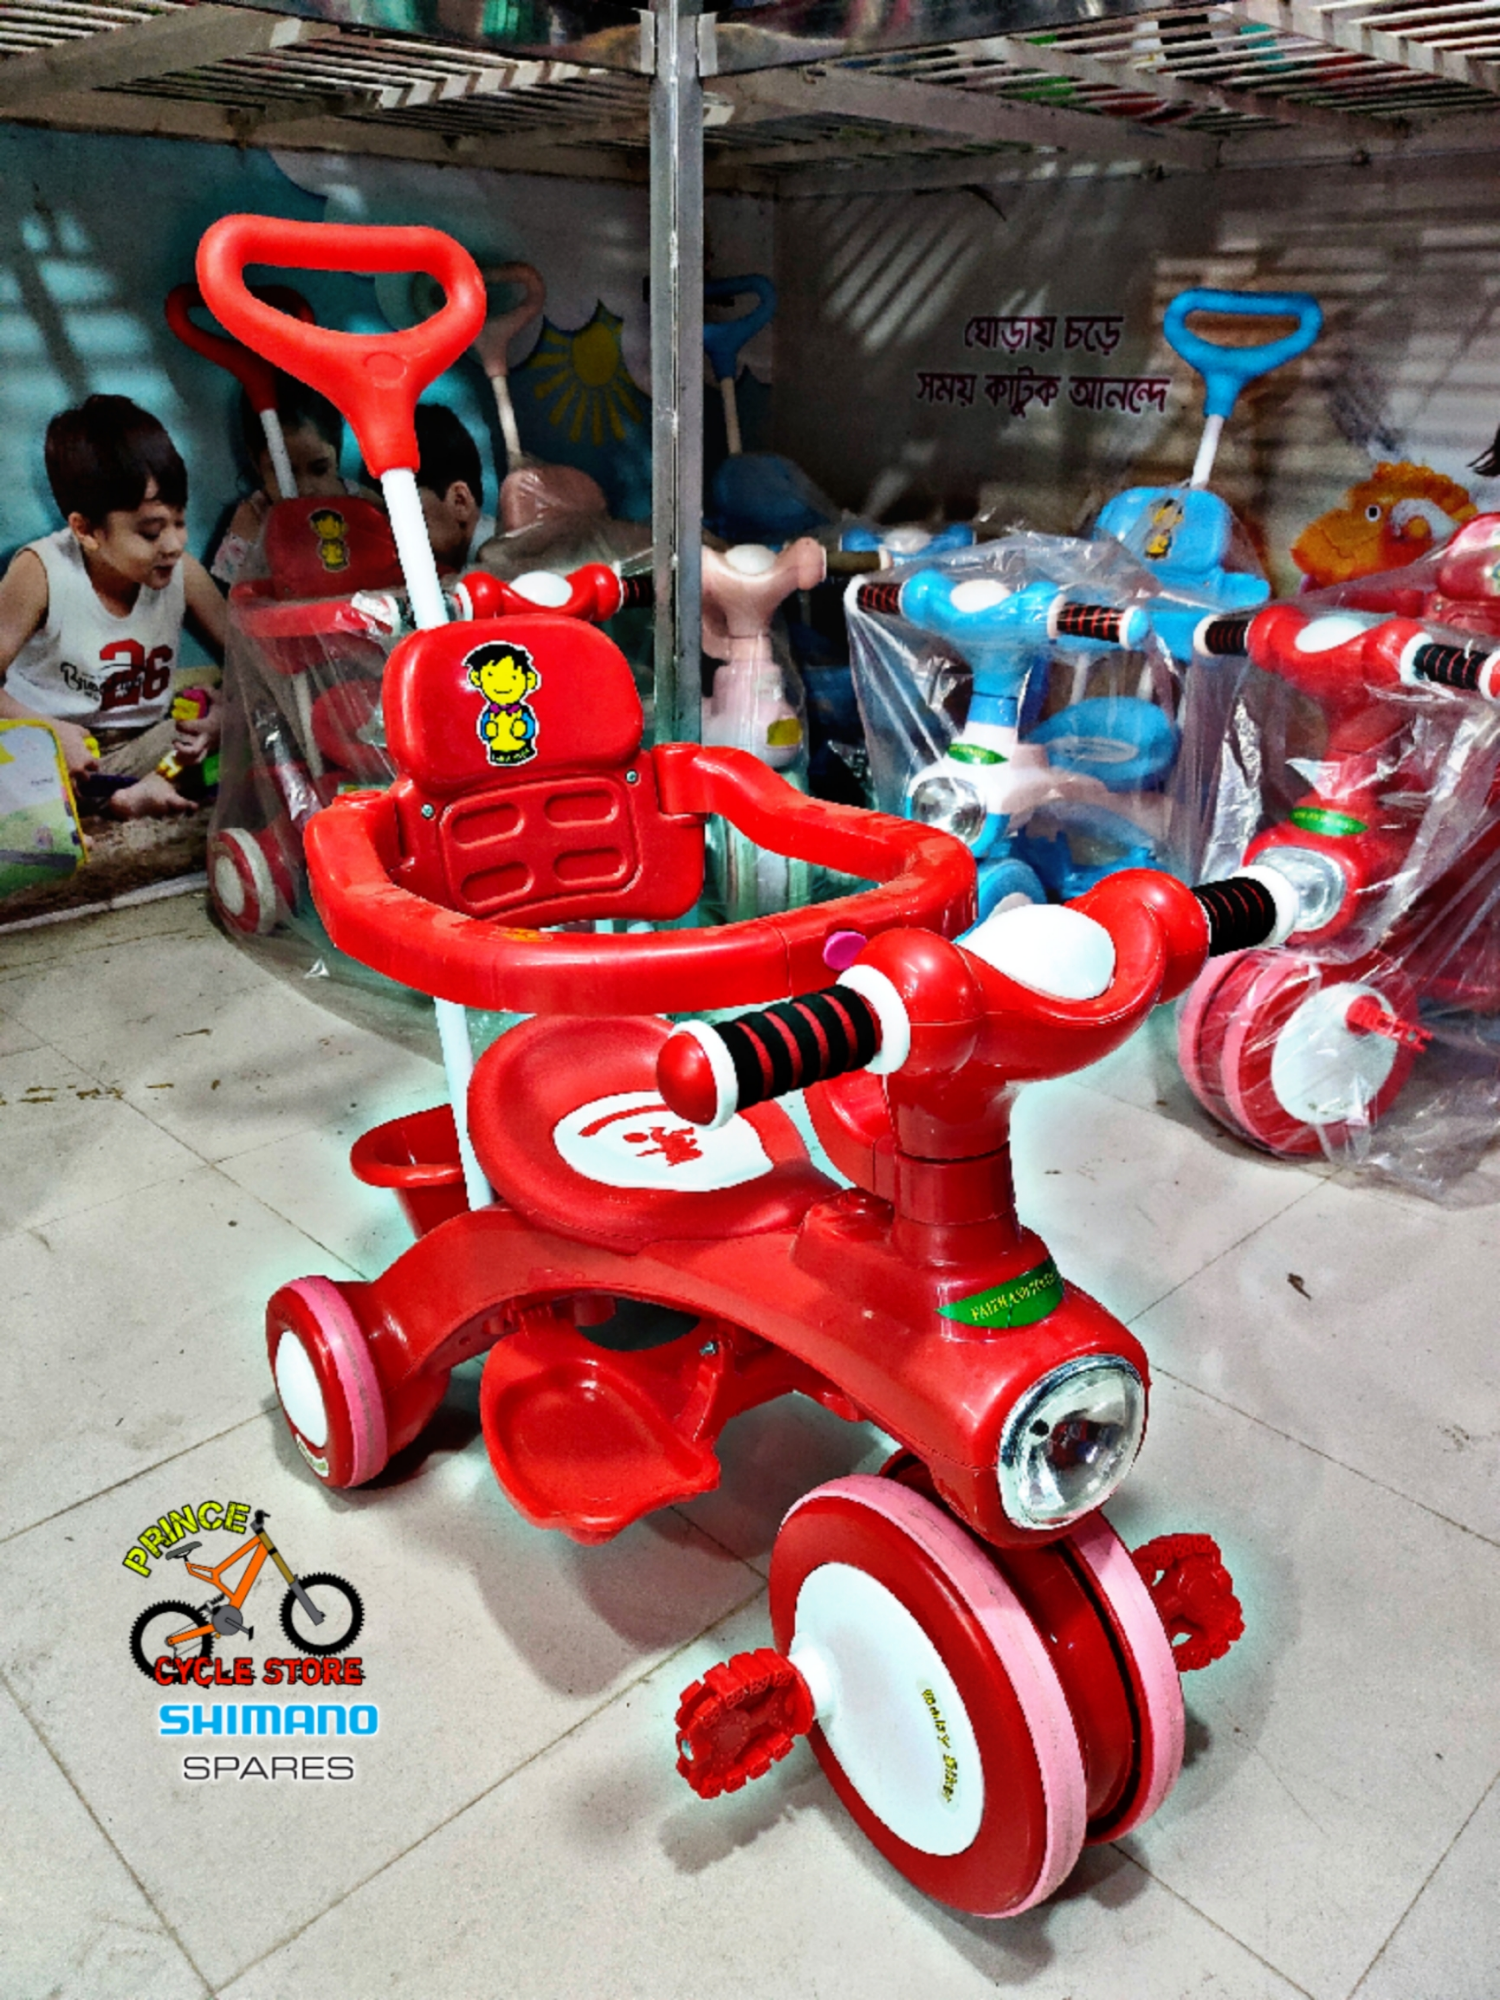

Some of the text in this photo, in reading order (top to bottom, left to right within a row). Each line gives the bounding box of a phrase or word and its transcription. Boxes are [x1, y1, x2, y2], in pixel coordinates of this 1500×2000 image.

[964, 315, 1124, 356] ঘোড়ায় চড়ে
[917, 366, 1171, 418] সময় কাটুক আনন্দে
